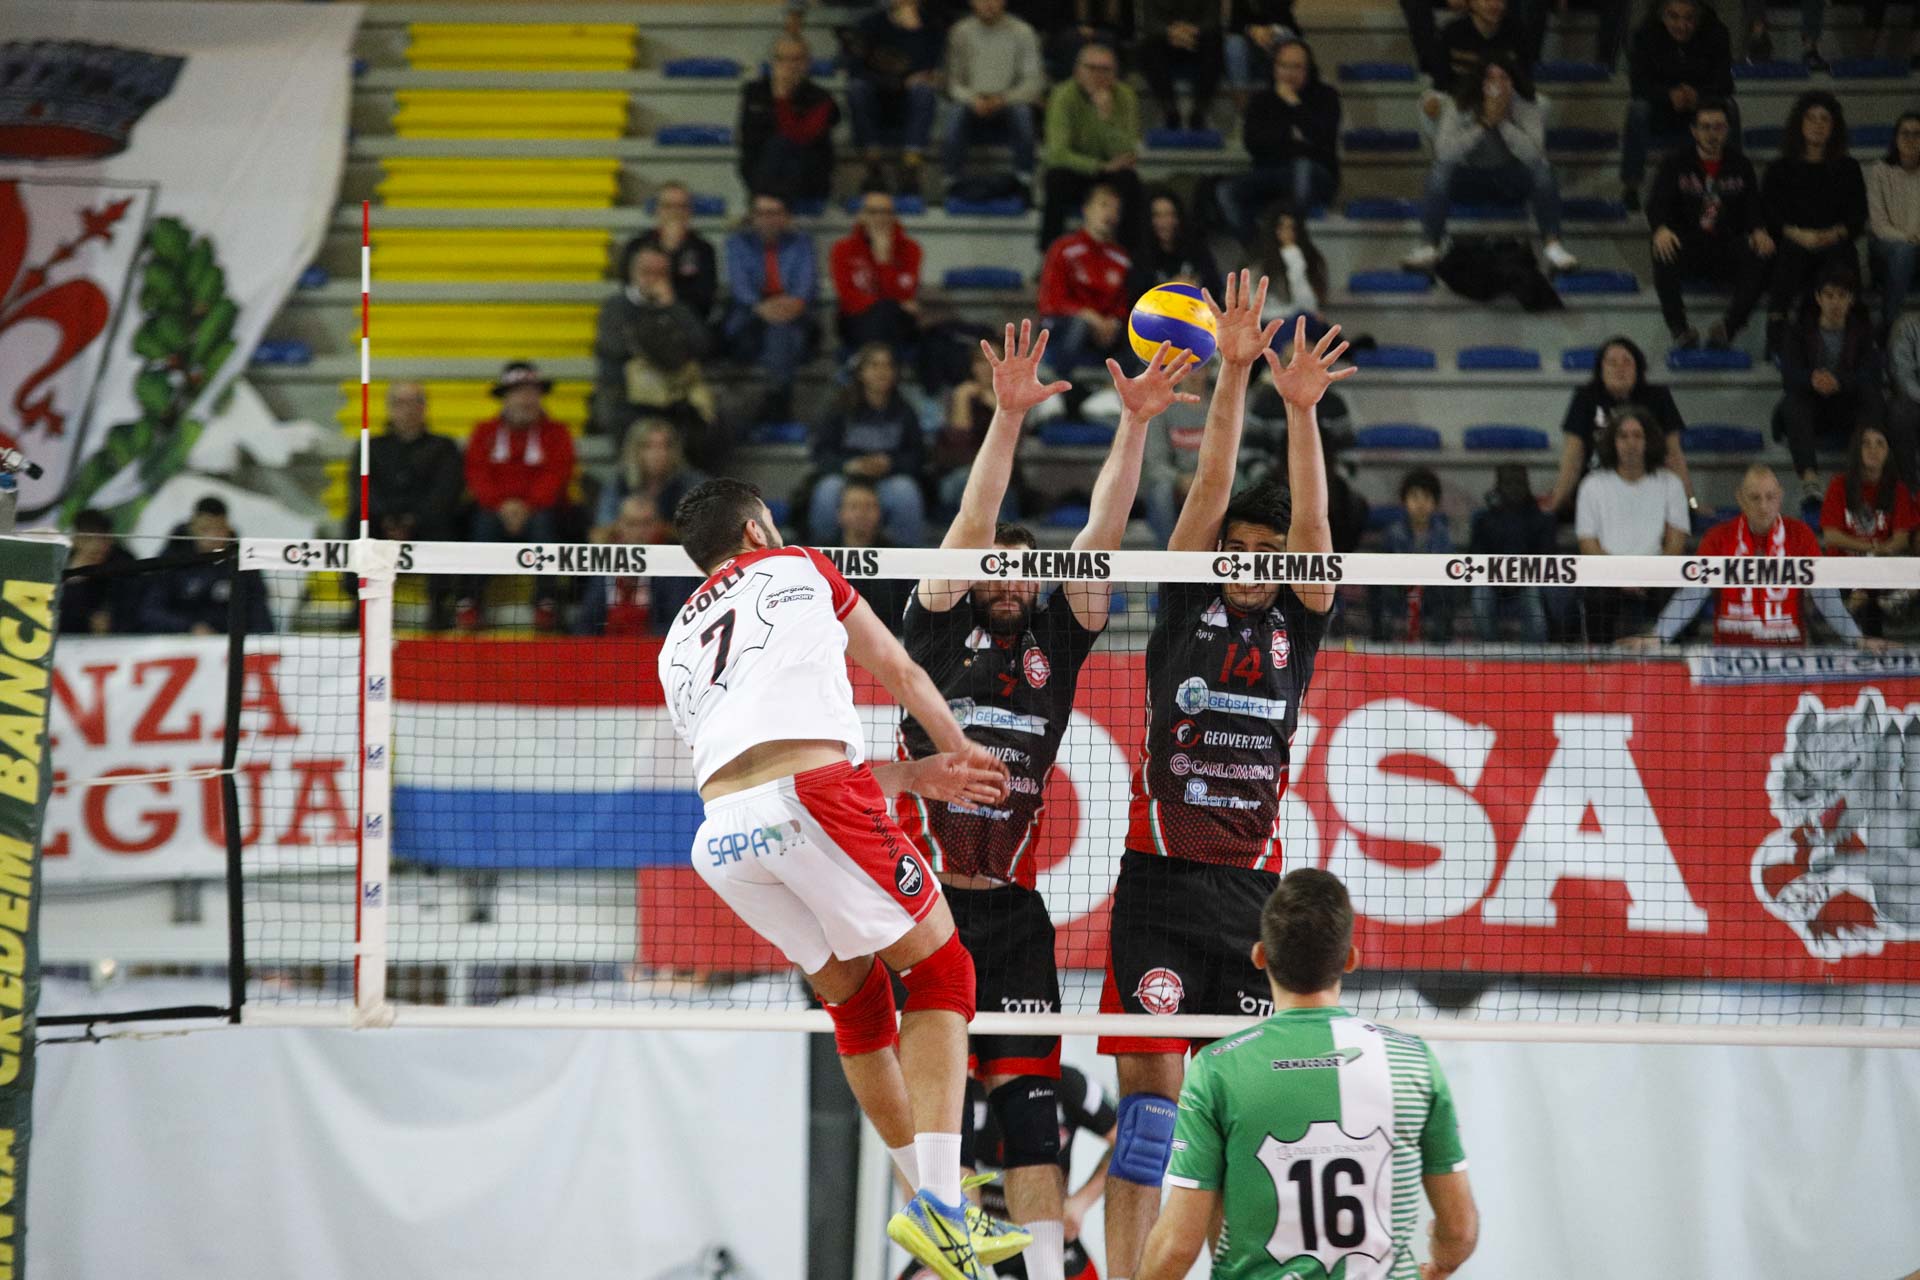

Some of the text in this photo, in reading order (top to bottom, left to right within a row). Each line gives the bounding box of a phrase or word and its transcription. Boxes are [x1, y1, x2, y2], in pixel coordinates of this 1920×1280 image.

[558, 545, 647, 573] KEMAS
[1021, 551, 1111, 579] KEMAS
[1254, 553, 1343, 581] KEMAS
[1487, 556, 1578, 584] KEMAS
[1723, 558, 1815, 586] KEMAS
[682, 565, 745, 626] COLLI
[700, 608, 736, 686] 7
[1219, 643, 1264, 687] 14
[0, 579, 57, 805] BANCA
[998, 672, 1019, 697] 7
[1209, 696, 1257, 712] GEOSAT
[1240, 996, 1274, 1017] OTI
[1287, 1157, 1367, 1251] 16
